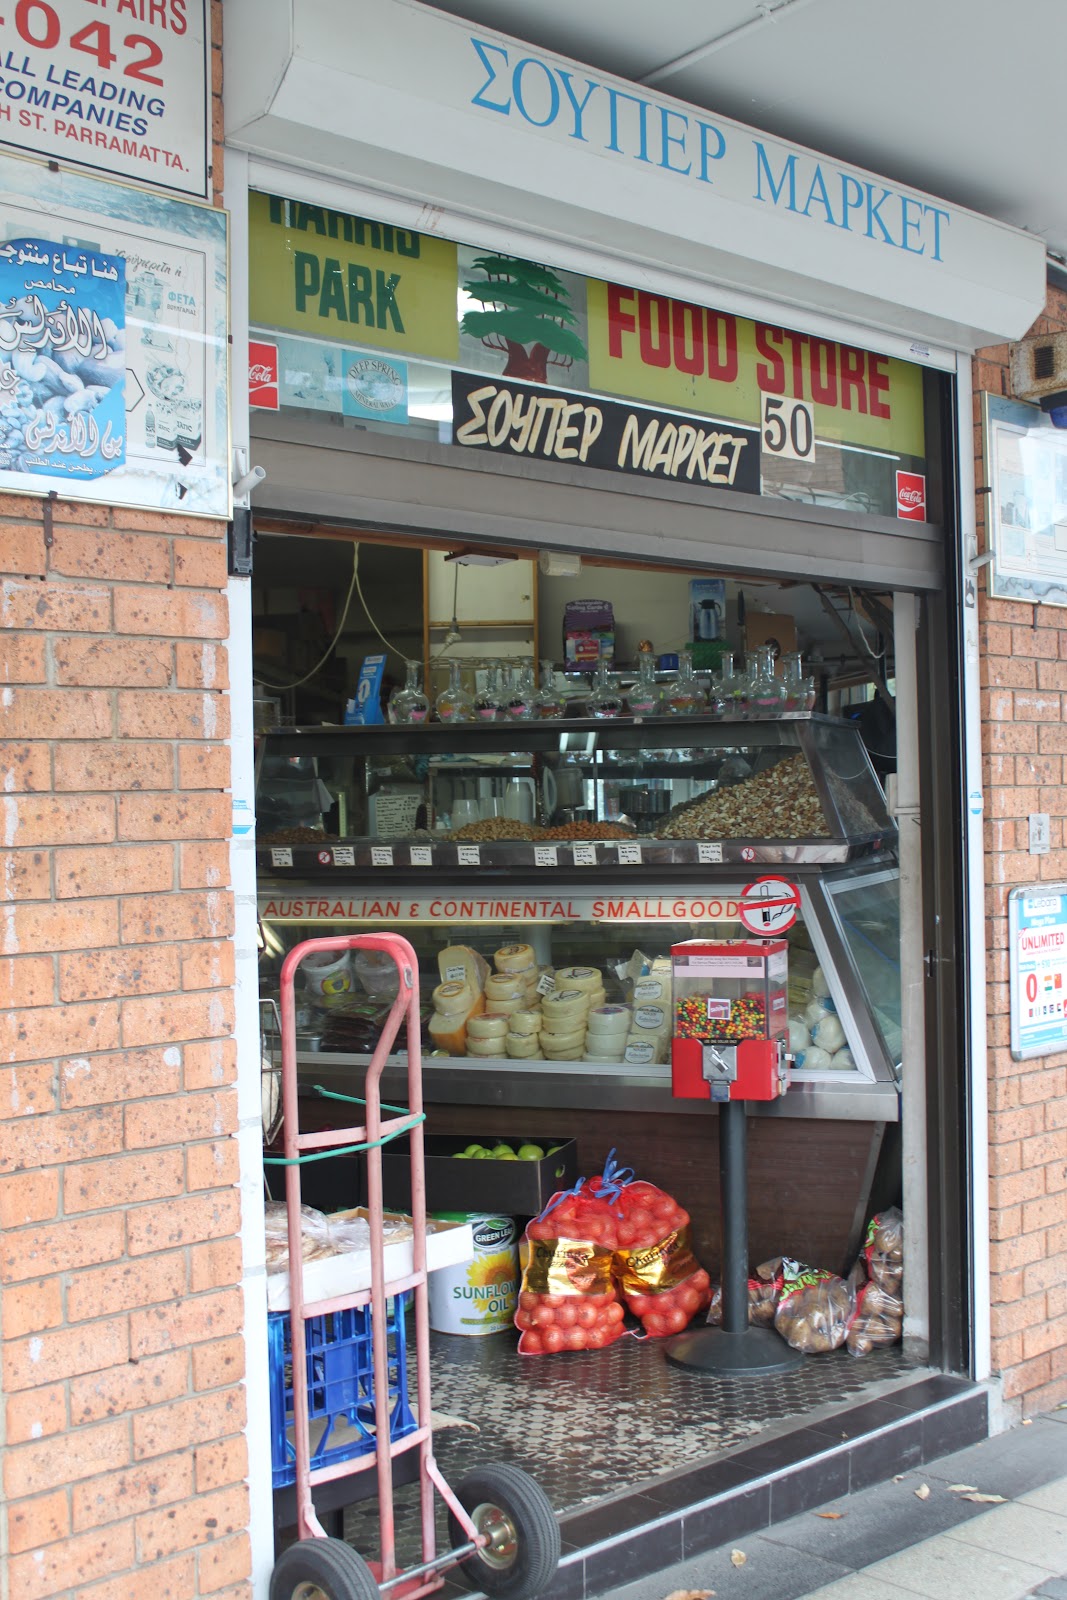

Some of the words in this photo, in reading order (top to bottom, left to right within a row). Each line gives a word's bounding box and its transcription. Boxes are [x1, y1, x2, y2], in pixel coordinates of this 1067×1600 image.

[0, 0, 164, 87] 042
[84, 0, 187, 35] AIRS
[0, 50, 36, 77] LL
[46, 64, 166, 117] LEADING
[0, 75, 149, 136] OMPANIES
[19, 109, 47, 132] ST.
[54, 118, 190, 172] PARRAMATTA.
[470, 37, 726, 184] ΣΟΥΠΕΡ
[751, 140, 951, 263] ΜΑΡΚΕΤ
[52, 252, 88, 278] تباع
[91, 258, 119, 282] هنا
[294, 251, 406, 334] PARK
[349, 360, 370, 379] DEEP
[607, 283, 738, 383] FOOD
[754, 321, 891, 420] STORE
[617, 414, 748, 486] ΜΑΡΚΕΤ
[764, 397, 812, 458] 50
[263, 901, 400, 918] AUSTRALIAN
[429, 900, 580, 918] CONTINENTAL
[592, 901, 740, 918] SMALLGOOD
[1021, 932, 1065, 951] UNLIMITED
[475, 1230, 500, 1242] GREEN
[488, 1298, 509, 1312] OIL
